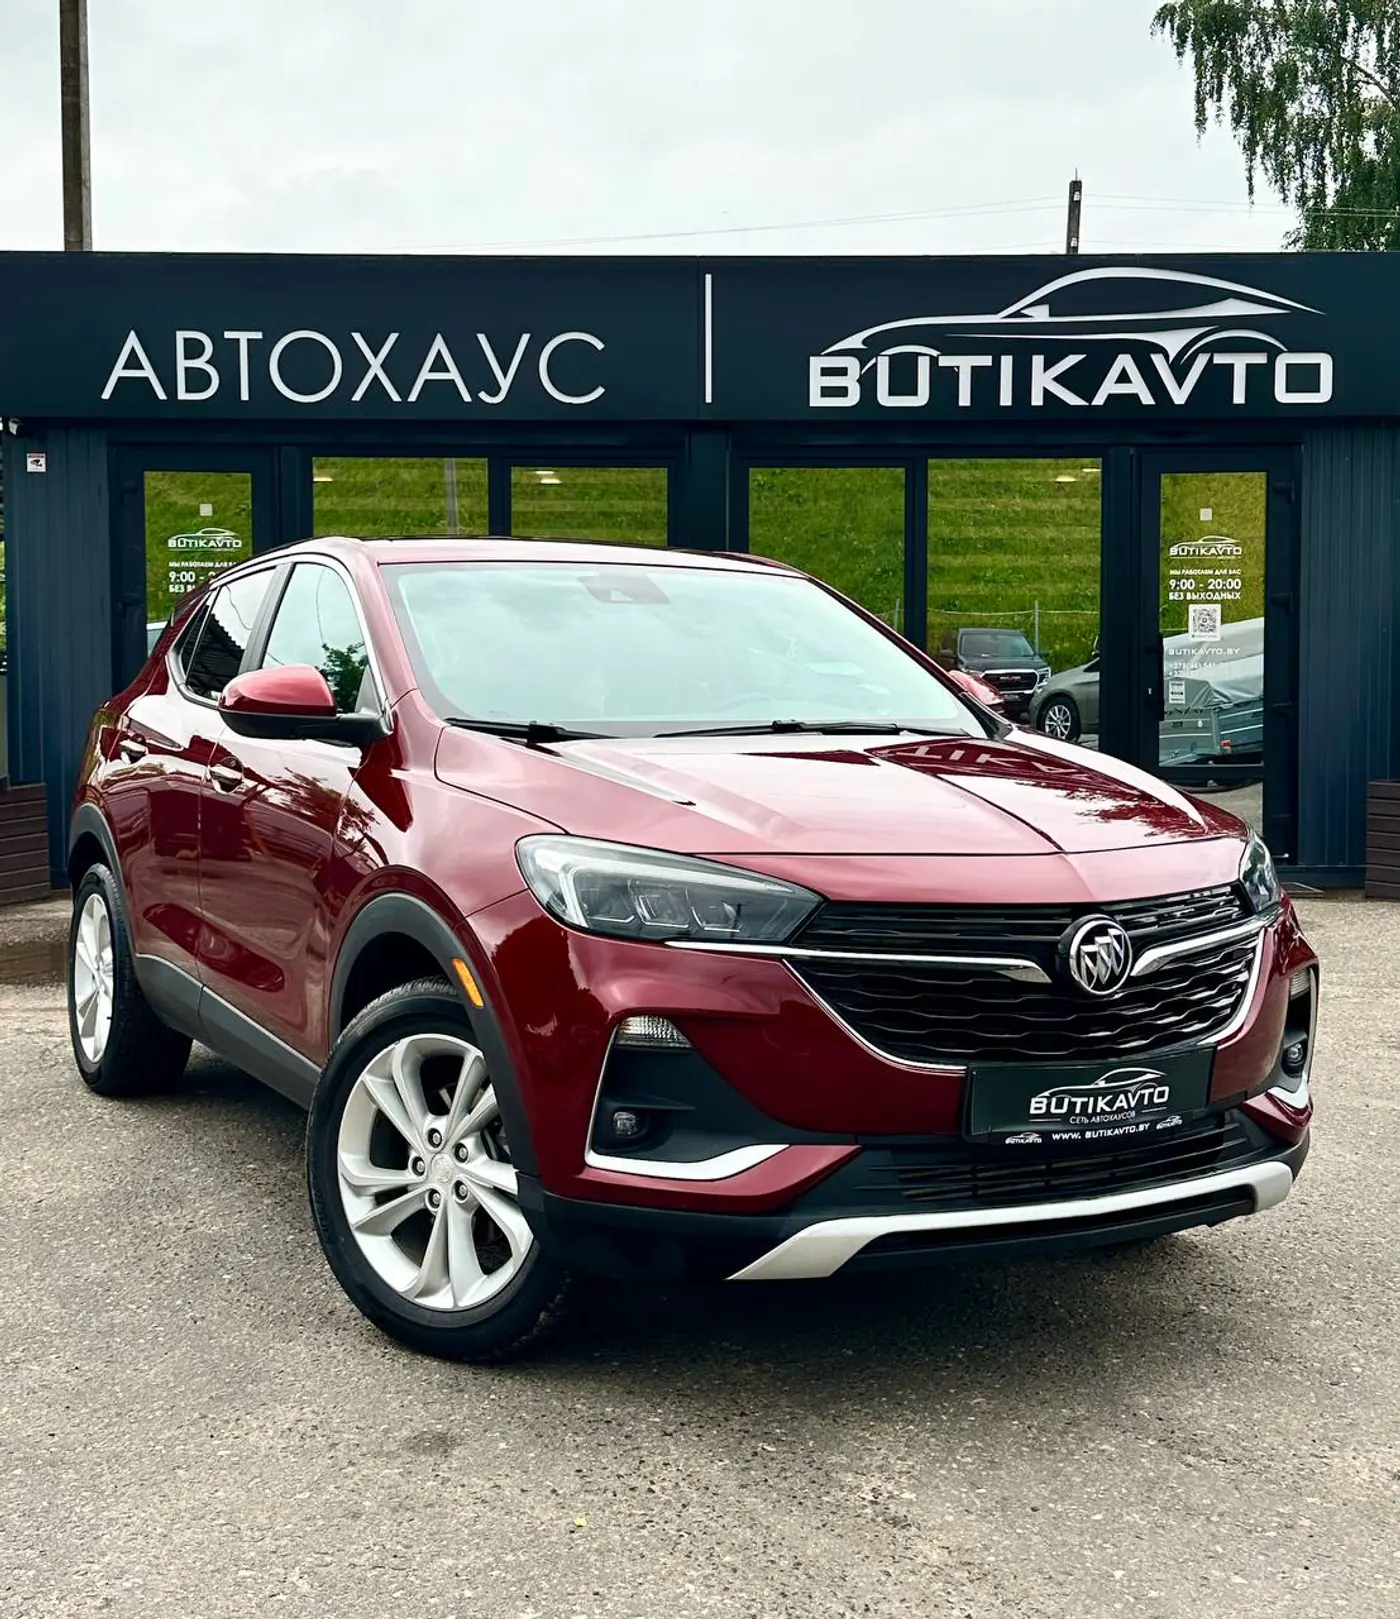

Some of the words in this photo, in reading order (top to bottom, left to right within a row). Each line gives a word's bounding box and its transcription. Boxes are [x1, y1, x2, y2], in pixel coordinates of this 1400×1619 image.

[101, 329, 606, 404] АВТОХАУС
[809, 350, 1334, 408] BUTIKAVTO
[168, 538, 242, 548] BUTIKAVTO
[1169, 546, 1242, 556] BUTIKAVTO
[169, 571, 196, 583] 9:00
[169, 585, 185, 593] БЕЗ
[1169, 579, 1196, 590] 9:00
[1207, 579, 1242, 590] 20:00
[1169, 592, 1184, 600] БЕЗ
[1186, 592, 1241, 600] ВЫХОДНЫХ
[1168, 647, 1241, 656] BUTIKAVTO.BY
[1029, 1085, 1170, 1115] BUTIKAVTO
[1069, 1115, 1089, 1125] СЕТЬ
[1091, 1110, 1136, 1124] АВТОХАУСОВ
